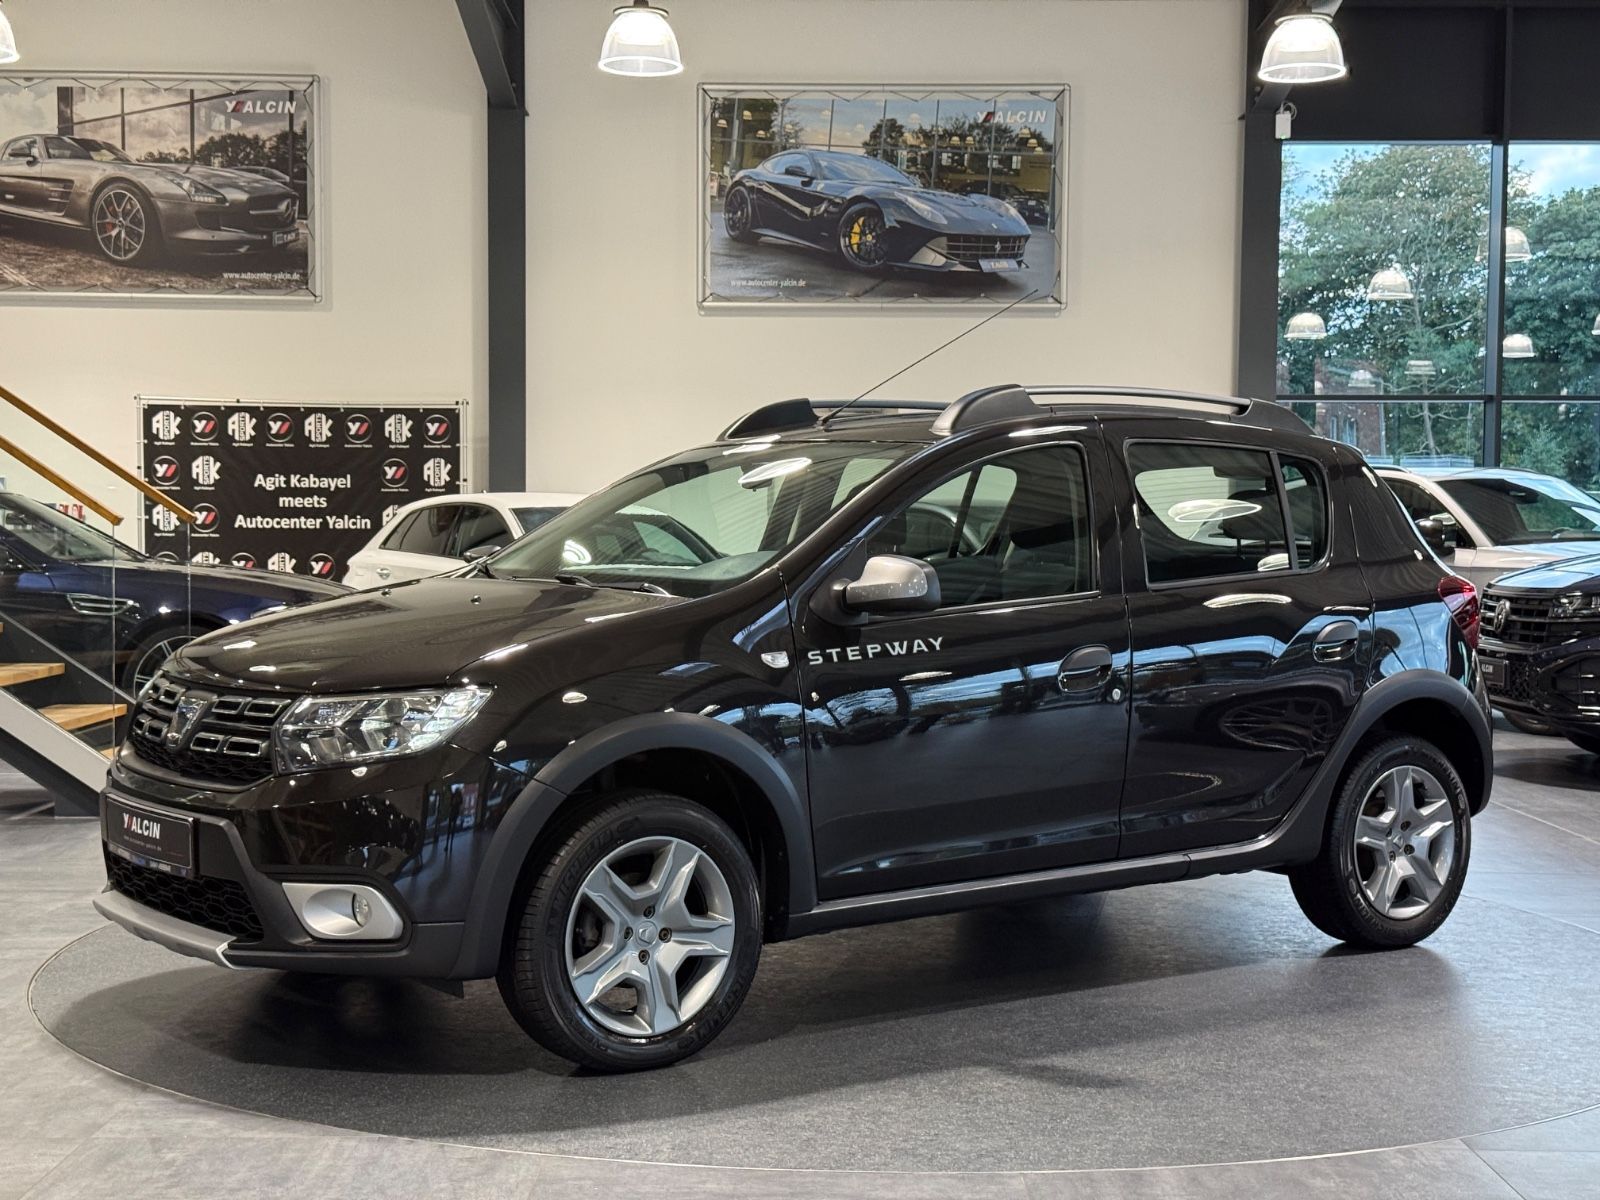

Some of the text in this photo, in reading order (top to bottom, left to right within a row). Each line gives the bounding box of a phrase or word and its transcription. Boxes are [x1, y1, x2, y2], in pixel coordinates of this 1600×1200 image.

[222, 271, 300, 280] www.autocenter-yalcin.de
[254, 473, 351, 491] Agit Kabayel
[279, 495, 328, 508] meets
[234, 514, 371, 529] Autocenter Yalcin
[807, 636, 943, 665] STEPWAY
